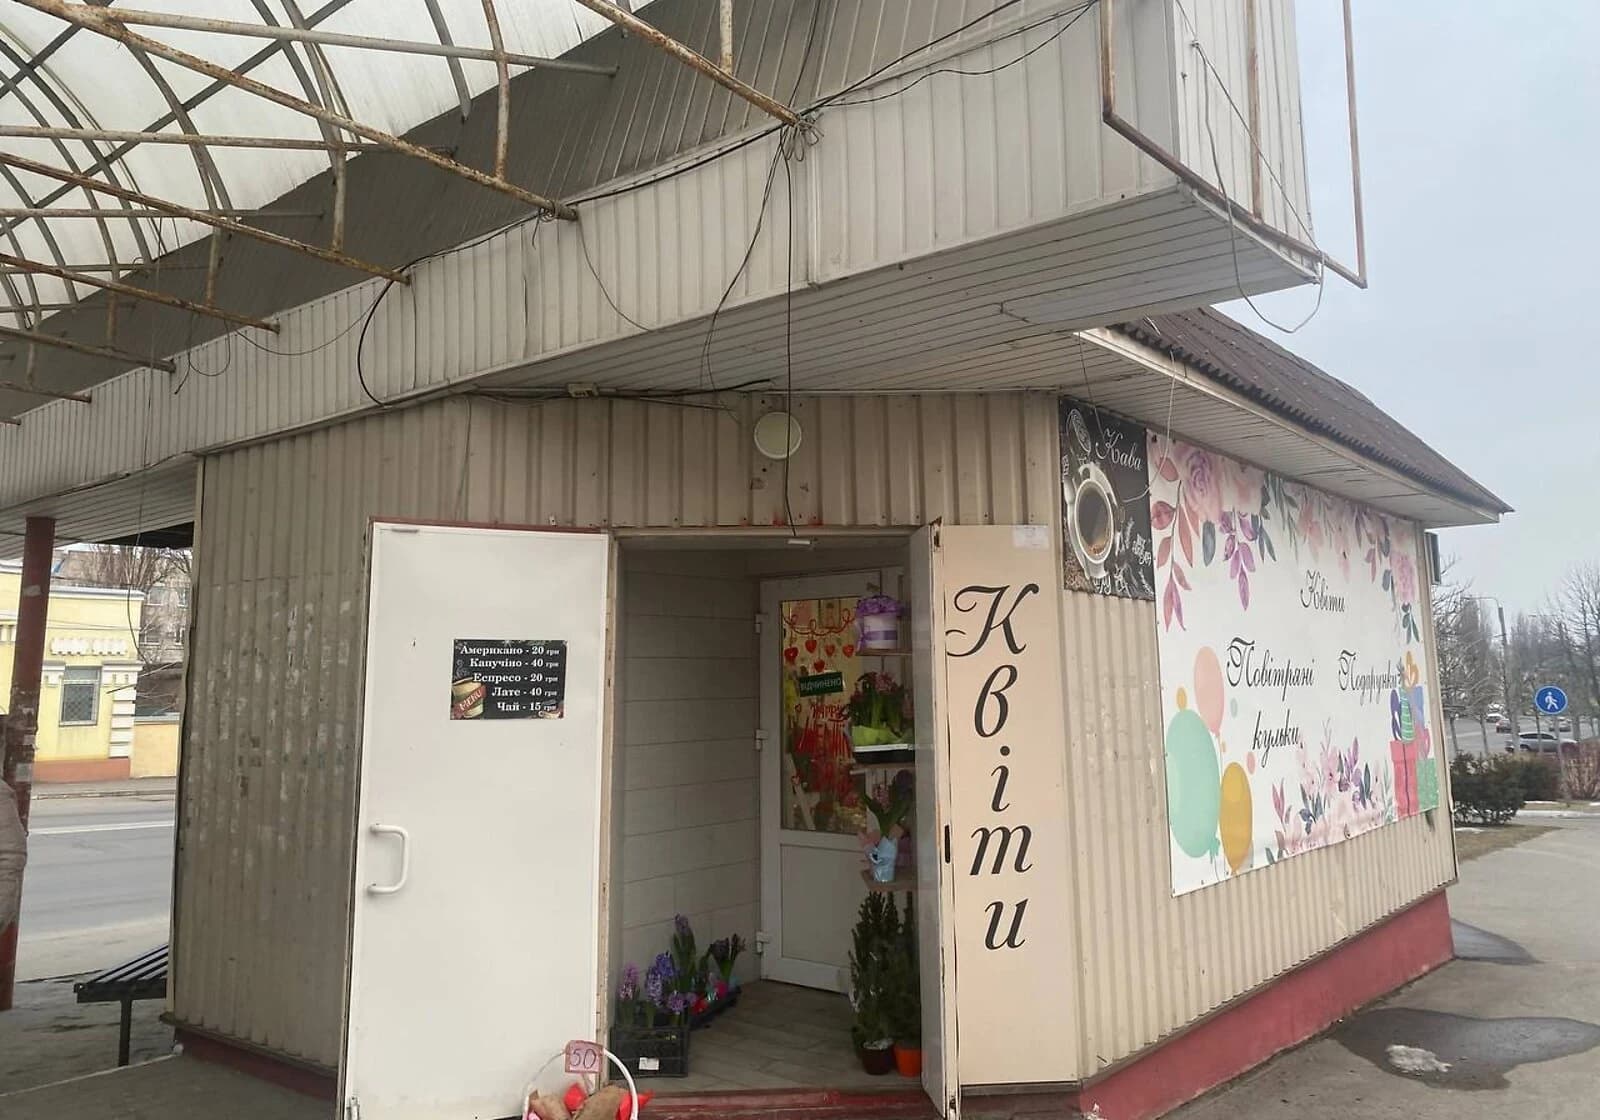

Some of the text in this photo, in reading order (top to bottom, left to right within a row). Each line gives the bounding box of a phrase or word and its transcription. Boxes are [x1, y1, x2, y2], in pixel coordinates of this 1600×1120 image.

[1095, 427, 1143, 472] Кава
[1300, 569, 1345, 613] Квіти
[460, 645, 523, 656] Американо
[531, 646, 544, 655] 20
[546, 648, 560, 656] грн
[470, 658, 522, 669] Капучіно
[531, 658, 544, 667] 40
[473, 672, 521, 684] Еспресо
[530, 673, 543, 682] 20
[545, 675, 558, 683] грн
[491, 687, 521, 697] Лате
[529, 687, 542, 696] 40
[544, 690, 558, 698] грн
[497, 701, 520, 711] Чай
[530, 702, 541, 711] 15
[1252, 708, 1300, 768] кульки
[944, 583, 1039, 951] Квіти
[569, 1048, 597, 1069] 50
